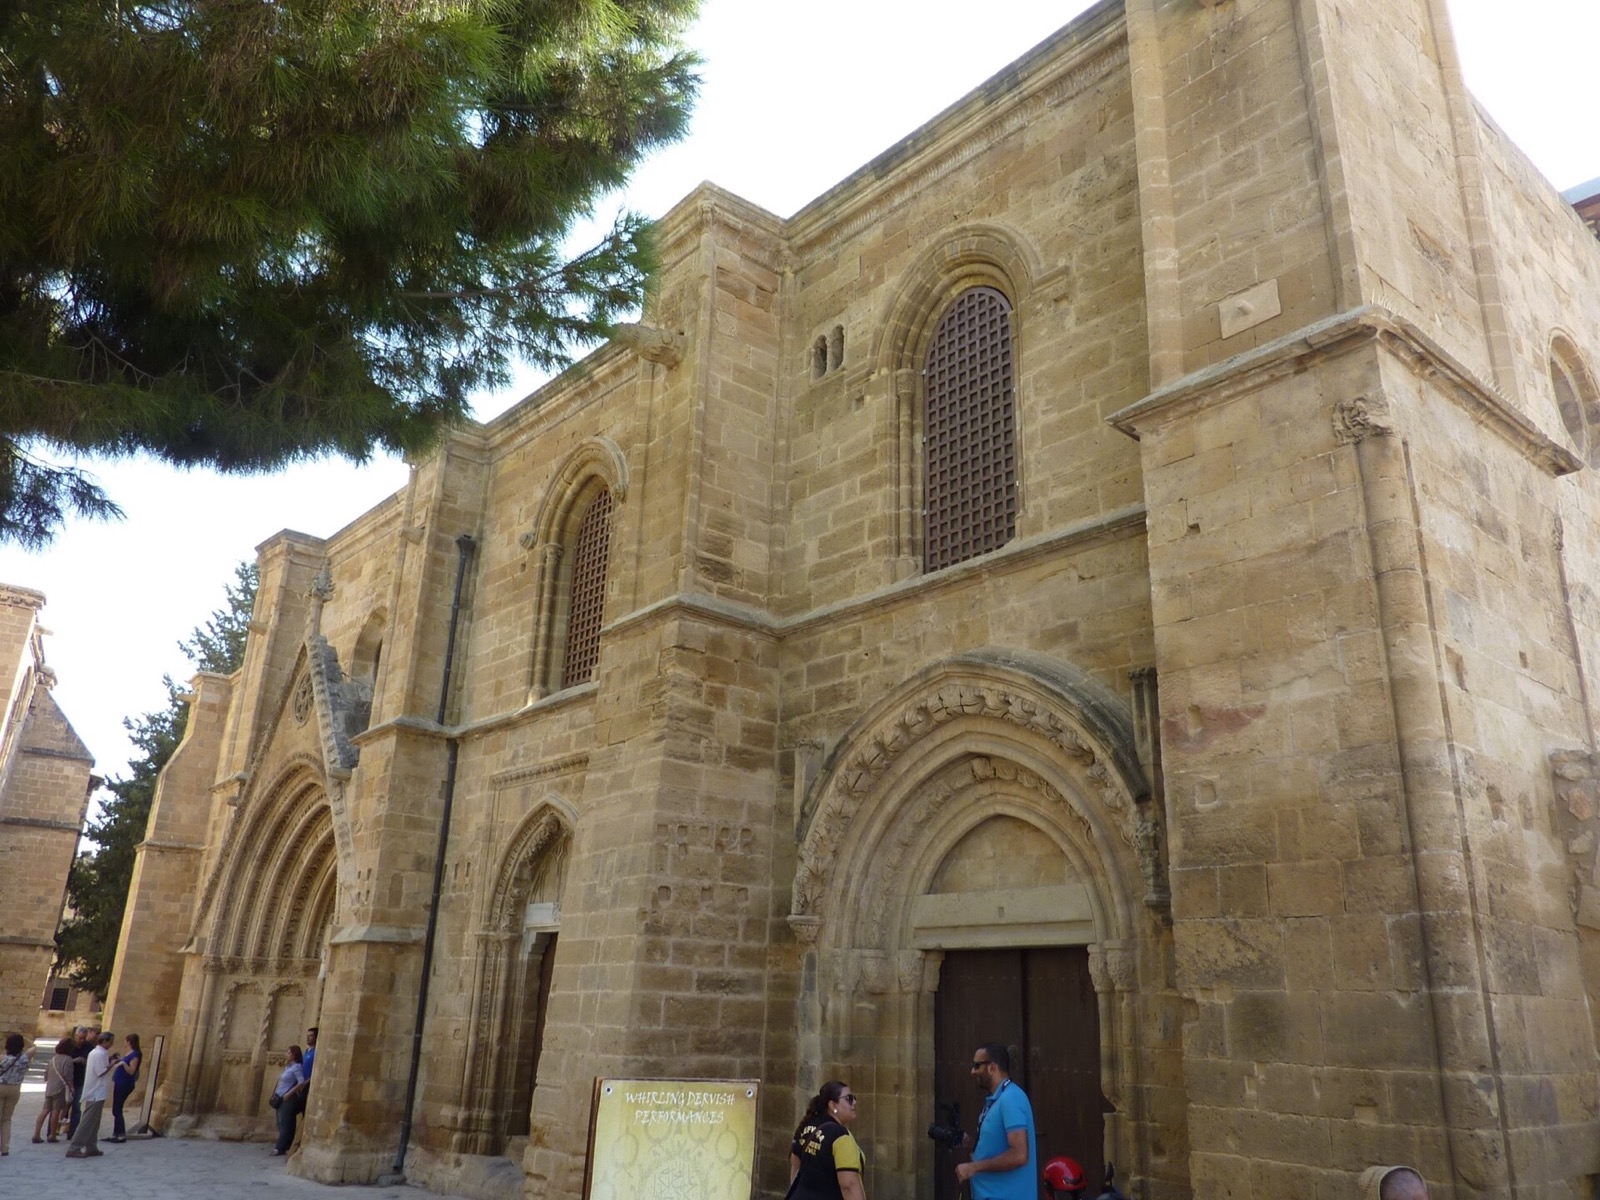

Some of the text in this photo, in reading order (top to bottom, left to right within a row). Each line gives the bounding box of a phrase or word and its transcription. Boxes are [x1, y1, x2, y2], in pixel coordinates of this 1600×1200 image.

[625, 1091, 736, 1108] WHIRLING DERVISH
[634, 1109, 725, 1126] PERFORMANCES
